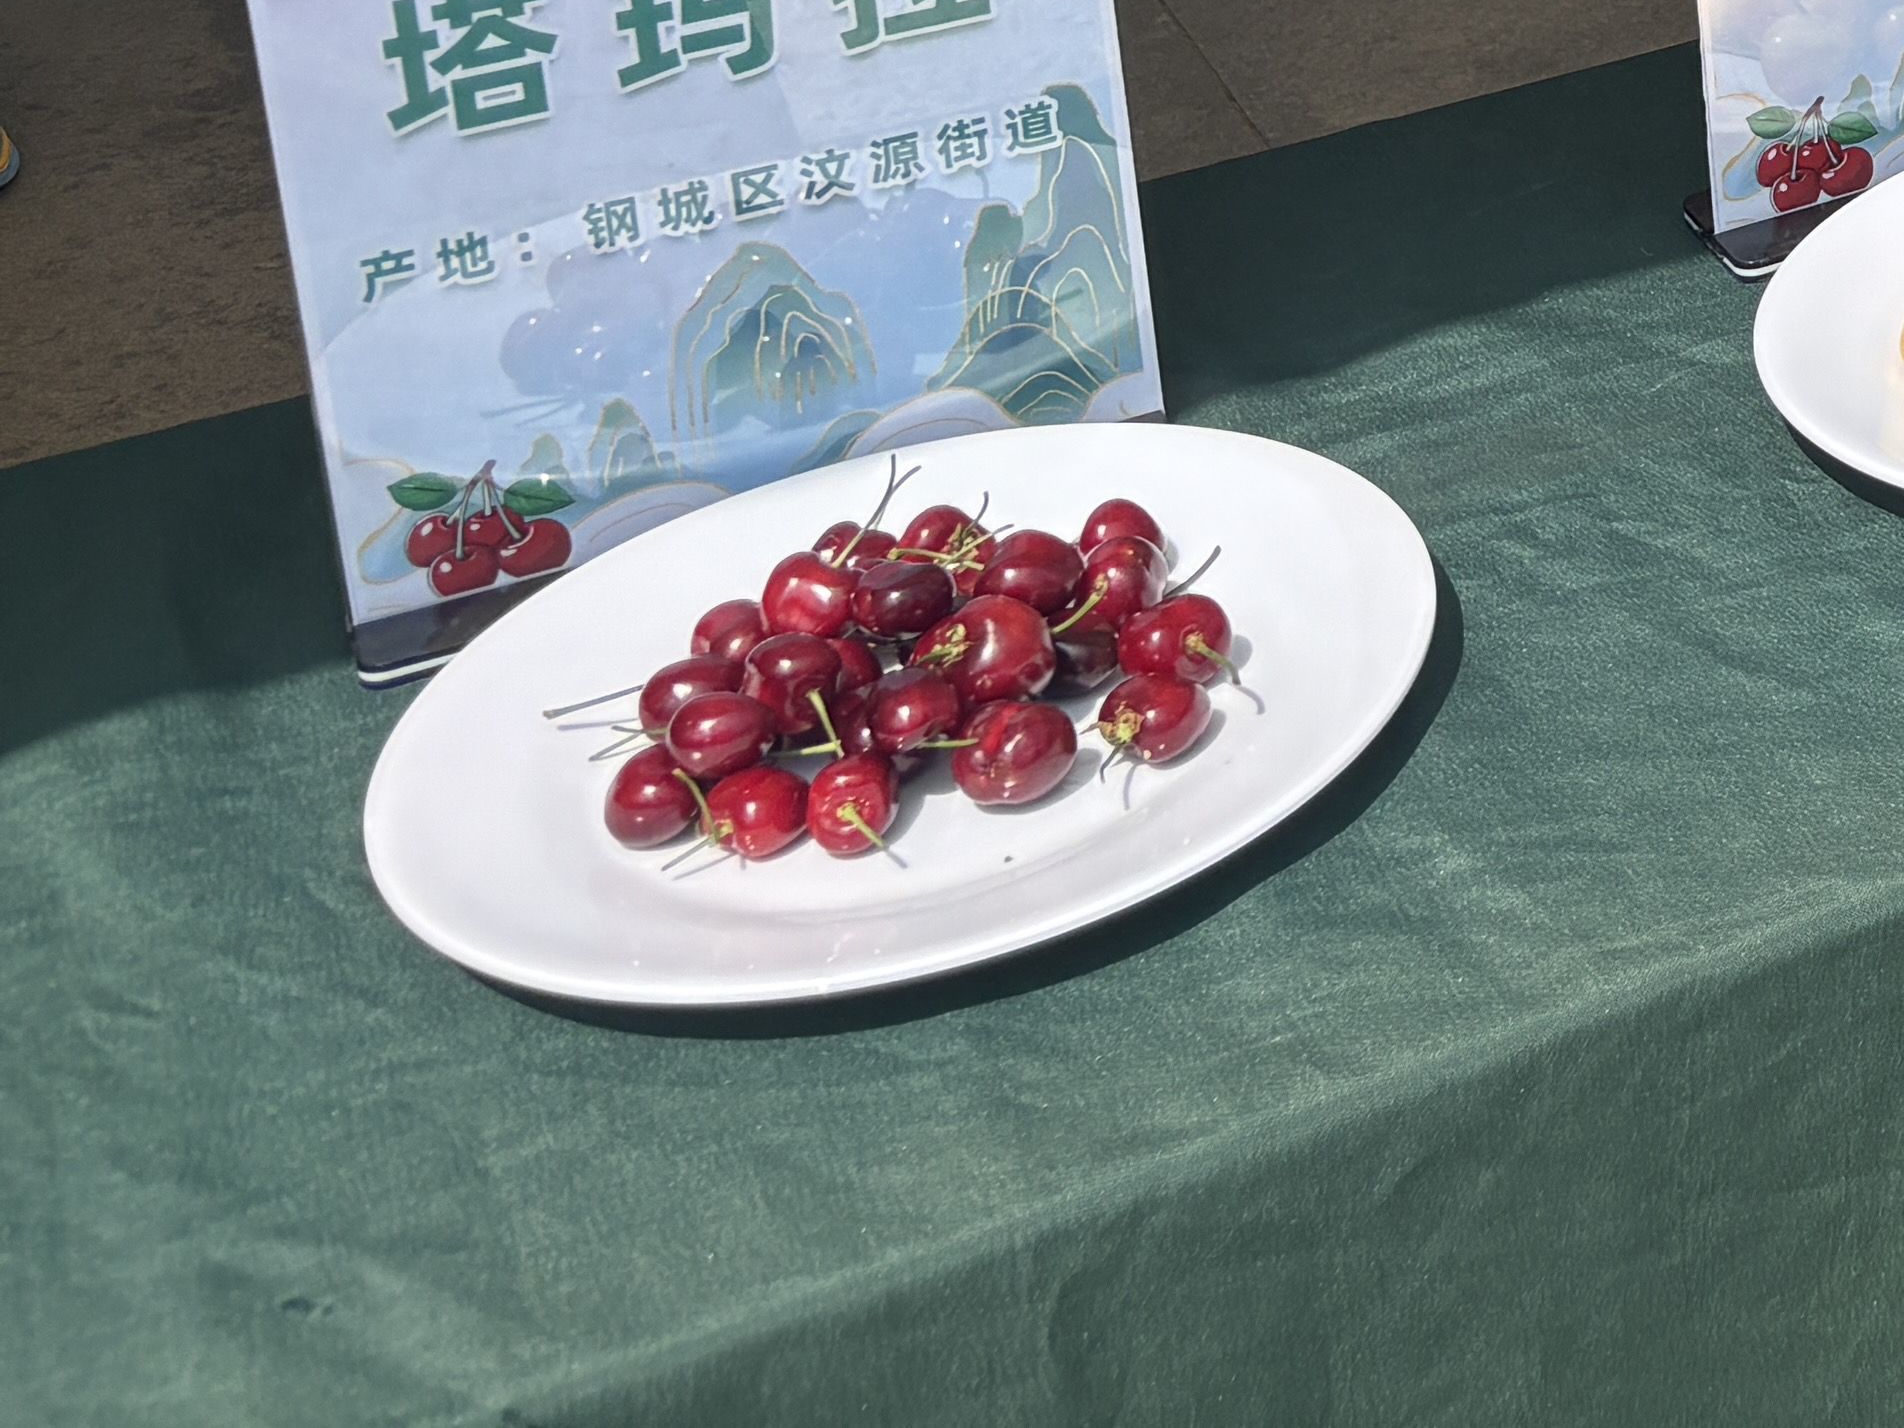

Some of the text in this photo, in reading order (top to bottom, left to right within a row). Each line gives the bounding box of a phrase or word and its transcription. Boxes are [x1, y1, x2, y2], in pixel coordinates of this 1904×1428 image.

[360, 98, 1062, 303] 产地：钢城区汶源街道
